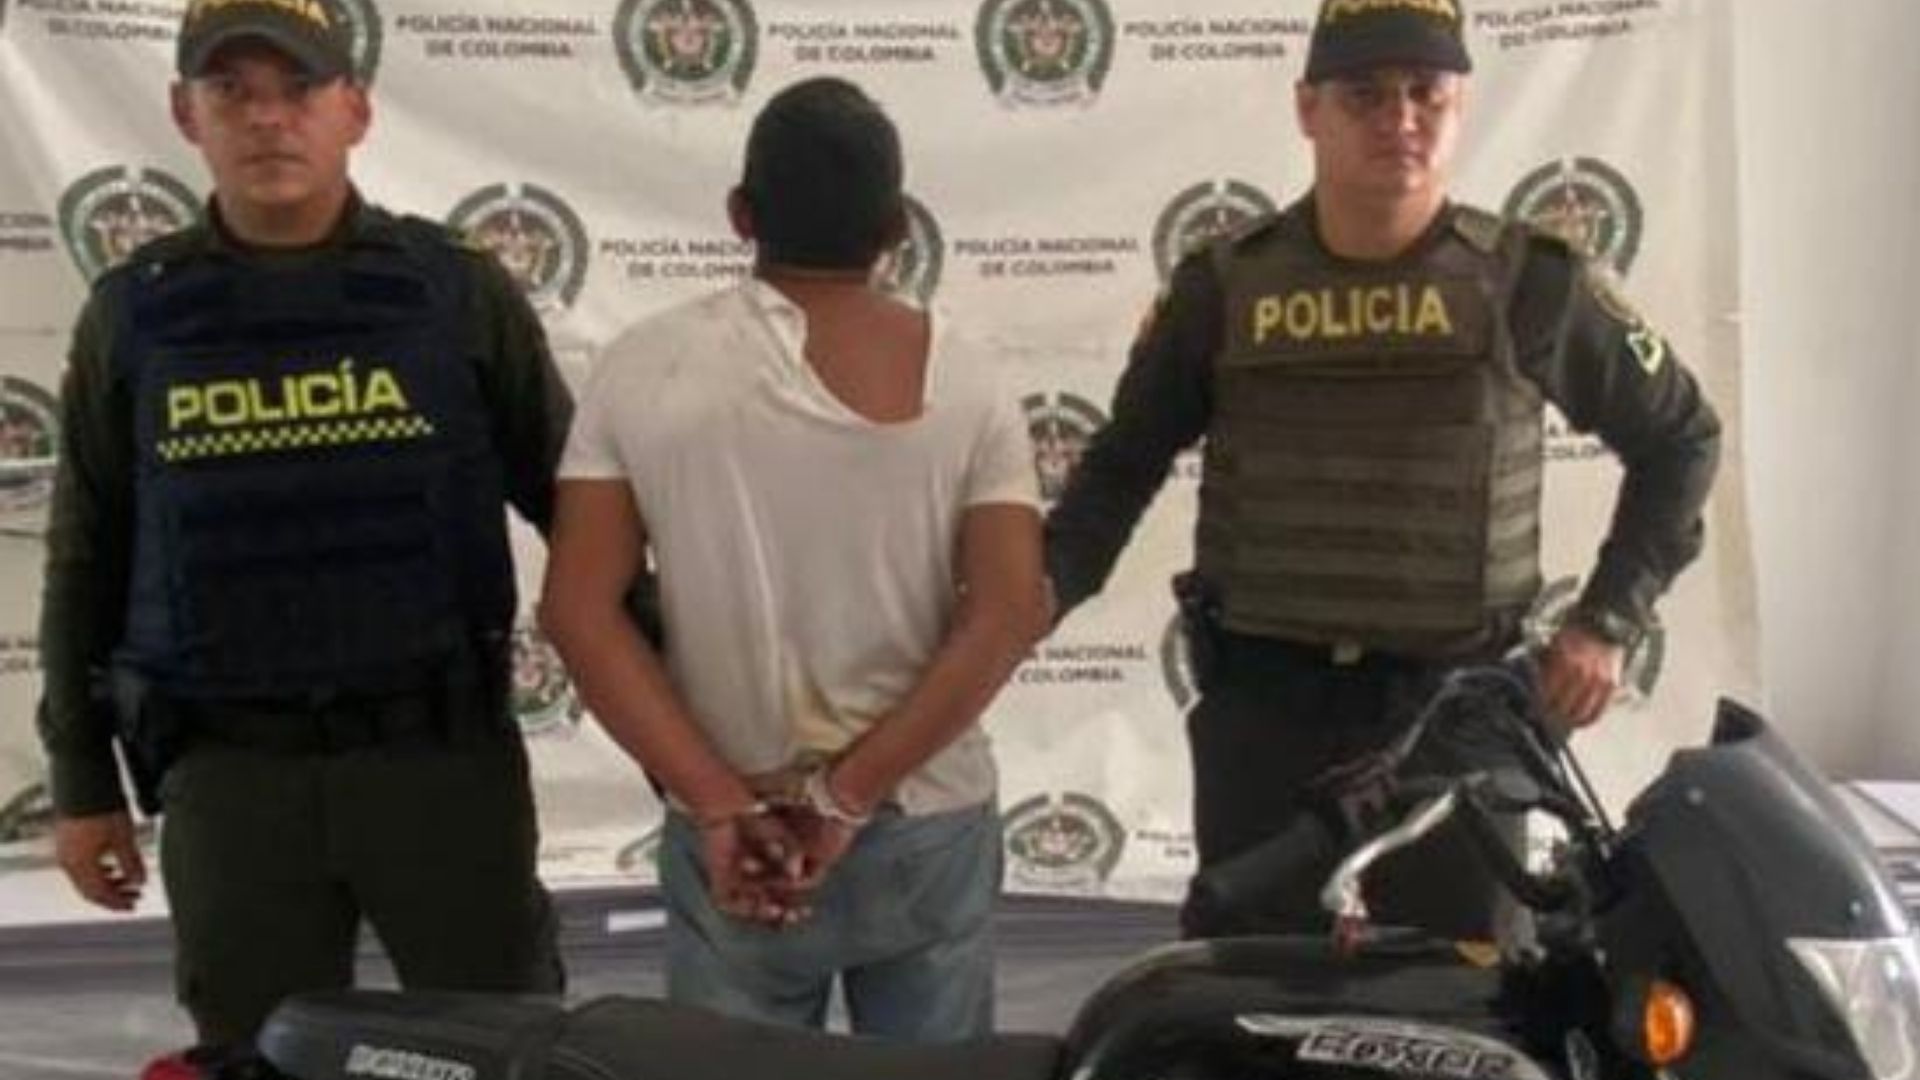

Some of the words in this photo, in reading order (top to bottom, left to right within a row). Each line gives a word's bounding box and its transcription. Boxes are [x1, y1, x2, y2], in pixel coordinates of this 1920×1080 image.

[424, 39, 452, 57] DE
[457, 39, 573, 58] COLOMBIA
[795, 46, 821, 62] DE
[827, 46, 934, 62] COLOMBIA
[1151, 42, 1176, 60] DE
[1181, 42, 1285, 60] COLOMBIA
[628, 262, 654, 279] DE
[980, 260, 1005, 277] DE
[1010, 259, 1114, 277] COLOMBIA
[167, 356, 409, 430] POLICÍA
[1019, 666, 1125, 685] COLOMBIA
